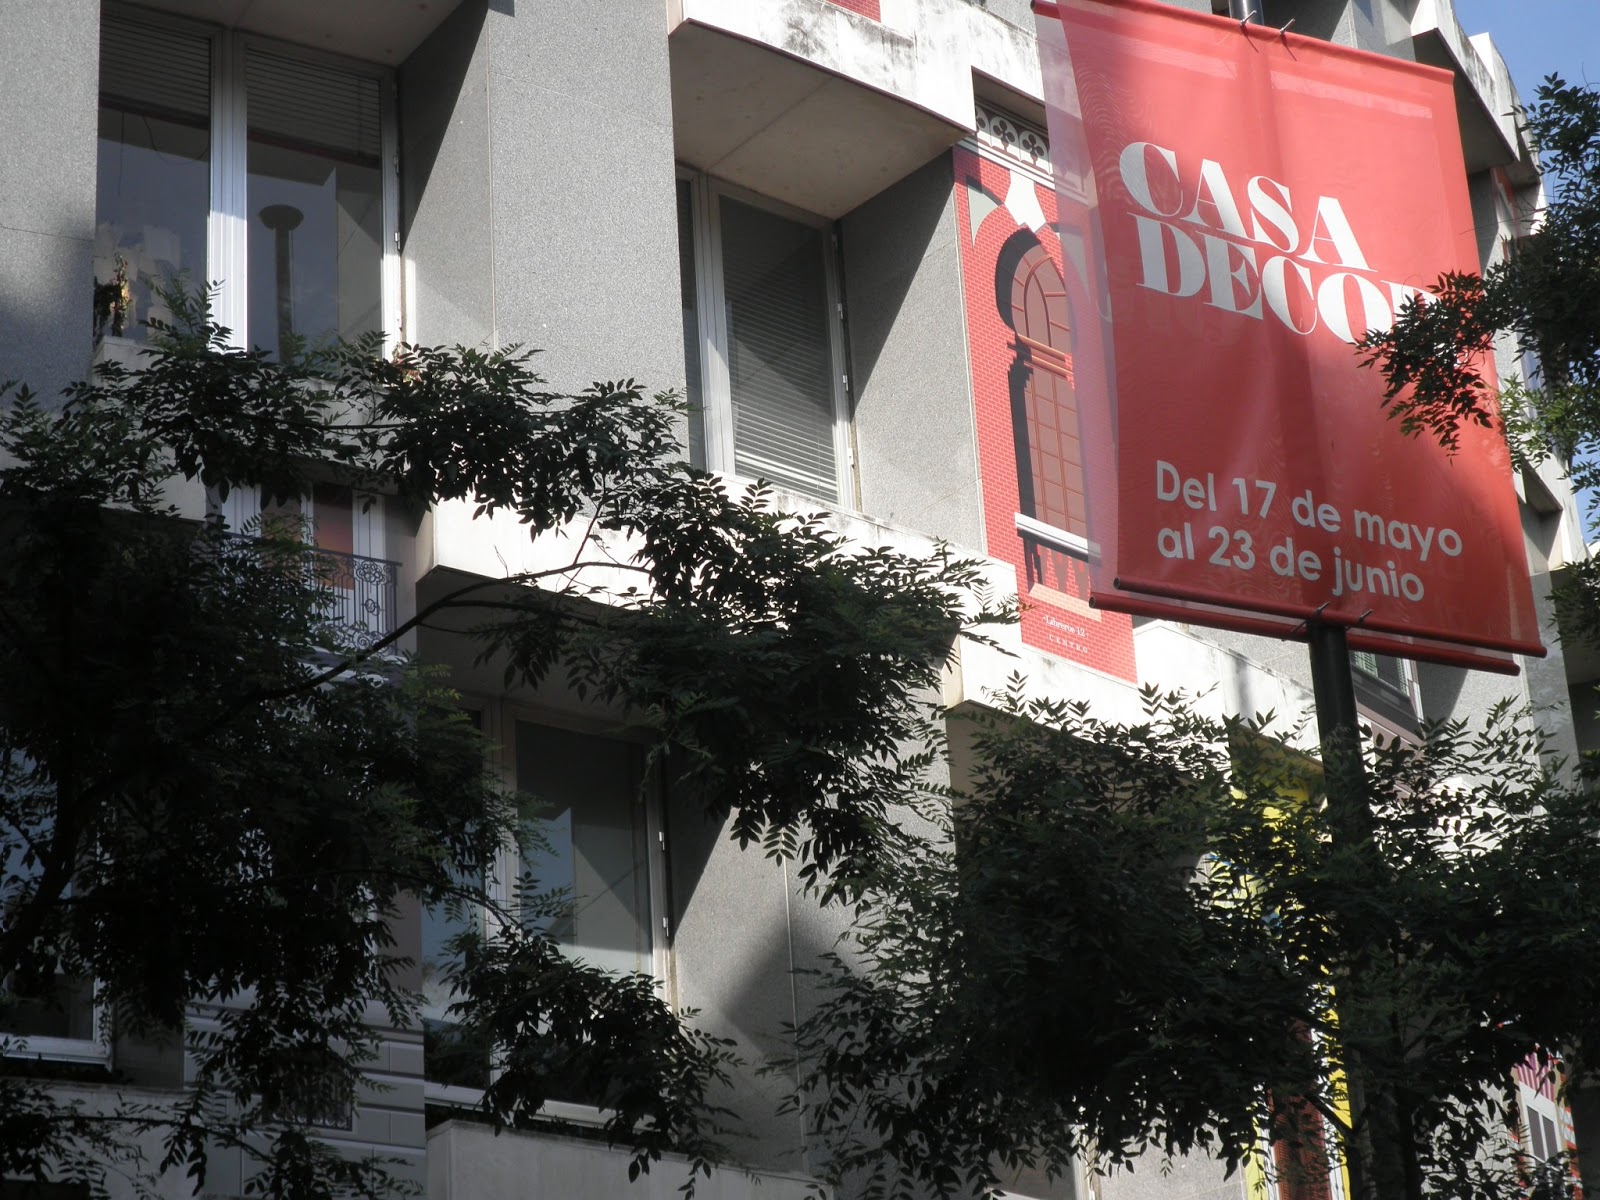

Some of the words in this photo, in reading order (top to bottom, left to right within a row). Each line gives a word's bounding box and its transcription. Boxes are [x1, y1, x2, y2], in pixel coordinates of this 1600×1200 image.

[1119, 141, 1378, 272] CASA
[1156, 460, 1217, 512] Del
[1232, 478, 1277, 519] 17
[1292, 489, 1342, 533] de
[1353, 509, 1463, 561] mayo
[1157, 522, 1195, 560] al
[1208, 525, 1256, 570] 23
[1269, 537, 1322, 581] de
[1332, 547, 1425, 602] junio
[1049, 634, 1088, 654] CENTRO
